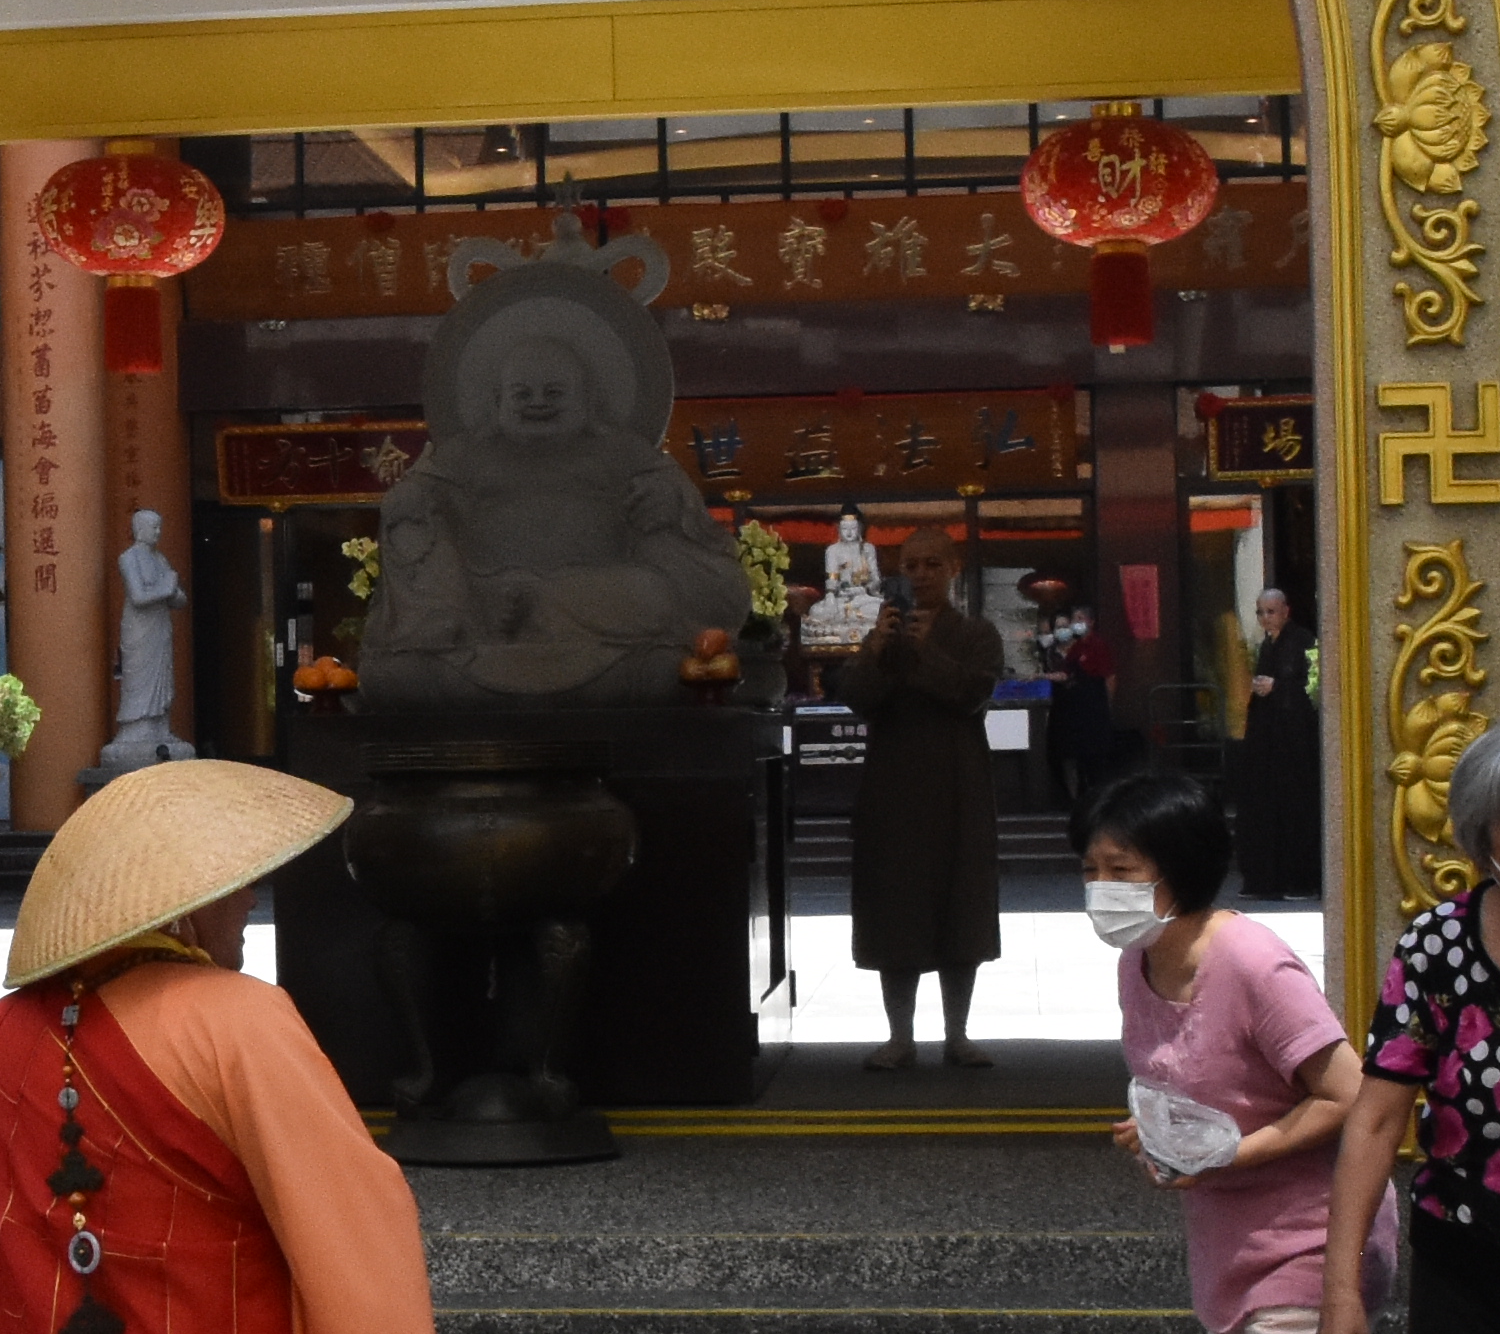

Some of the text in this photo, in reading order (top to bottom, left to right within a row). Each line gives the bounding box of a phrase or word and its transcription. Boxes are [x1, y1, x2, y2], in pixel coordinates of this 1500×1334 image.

[691, 213, 1021, 289] 大雄寶殿
[687, 406, 1036, 482] 弘法益世
